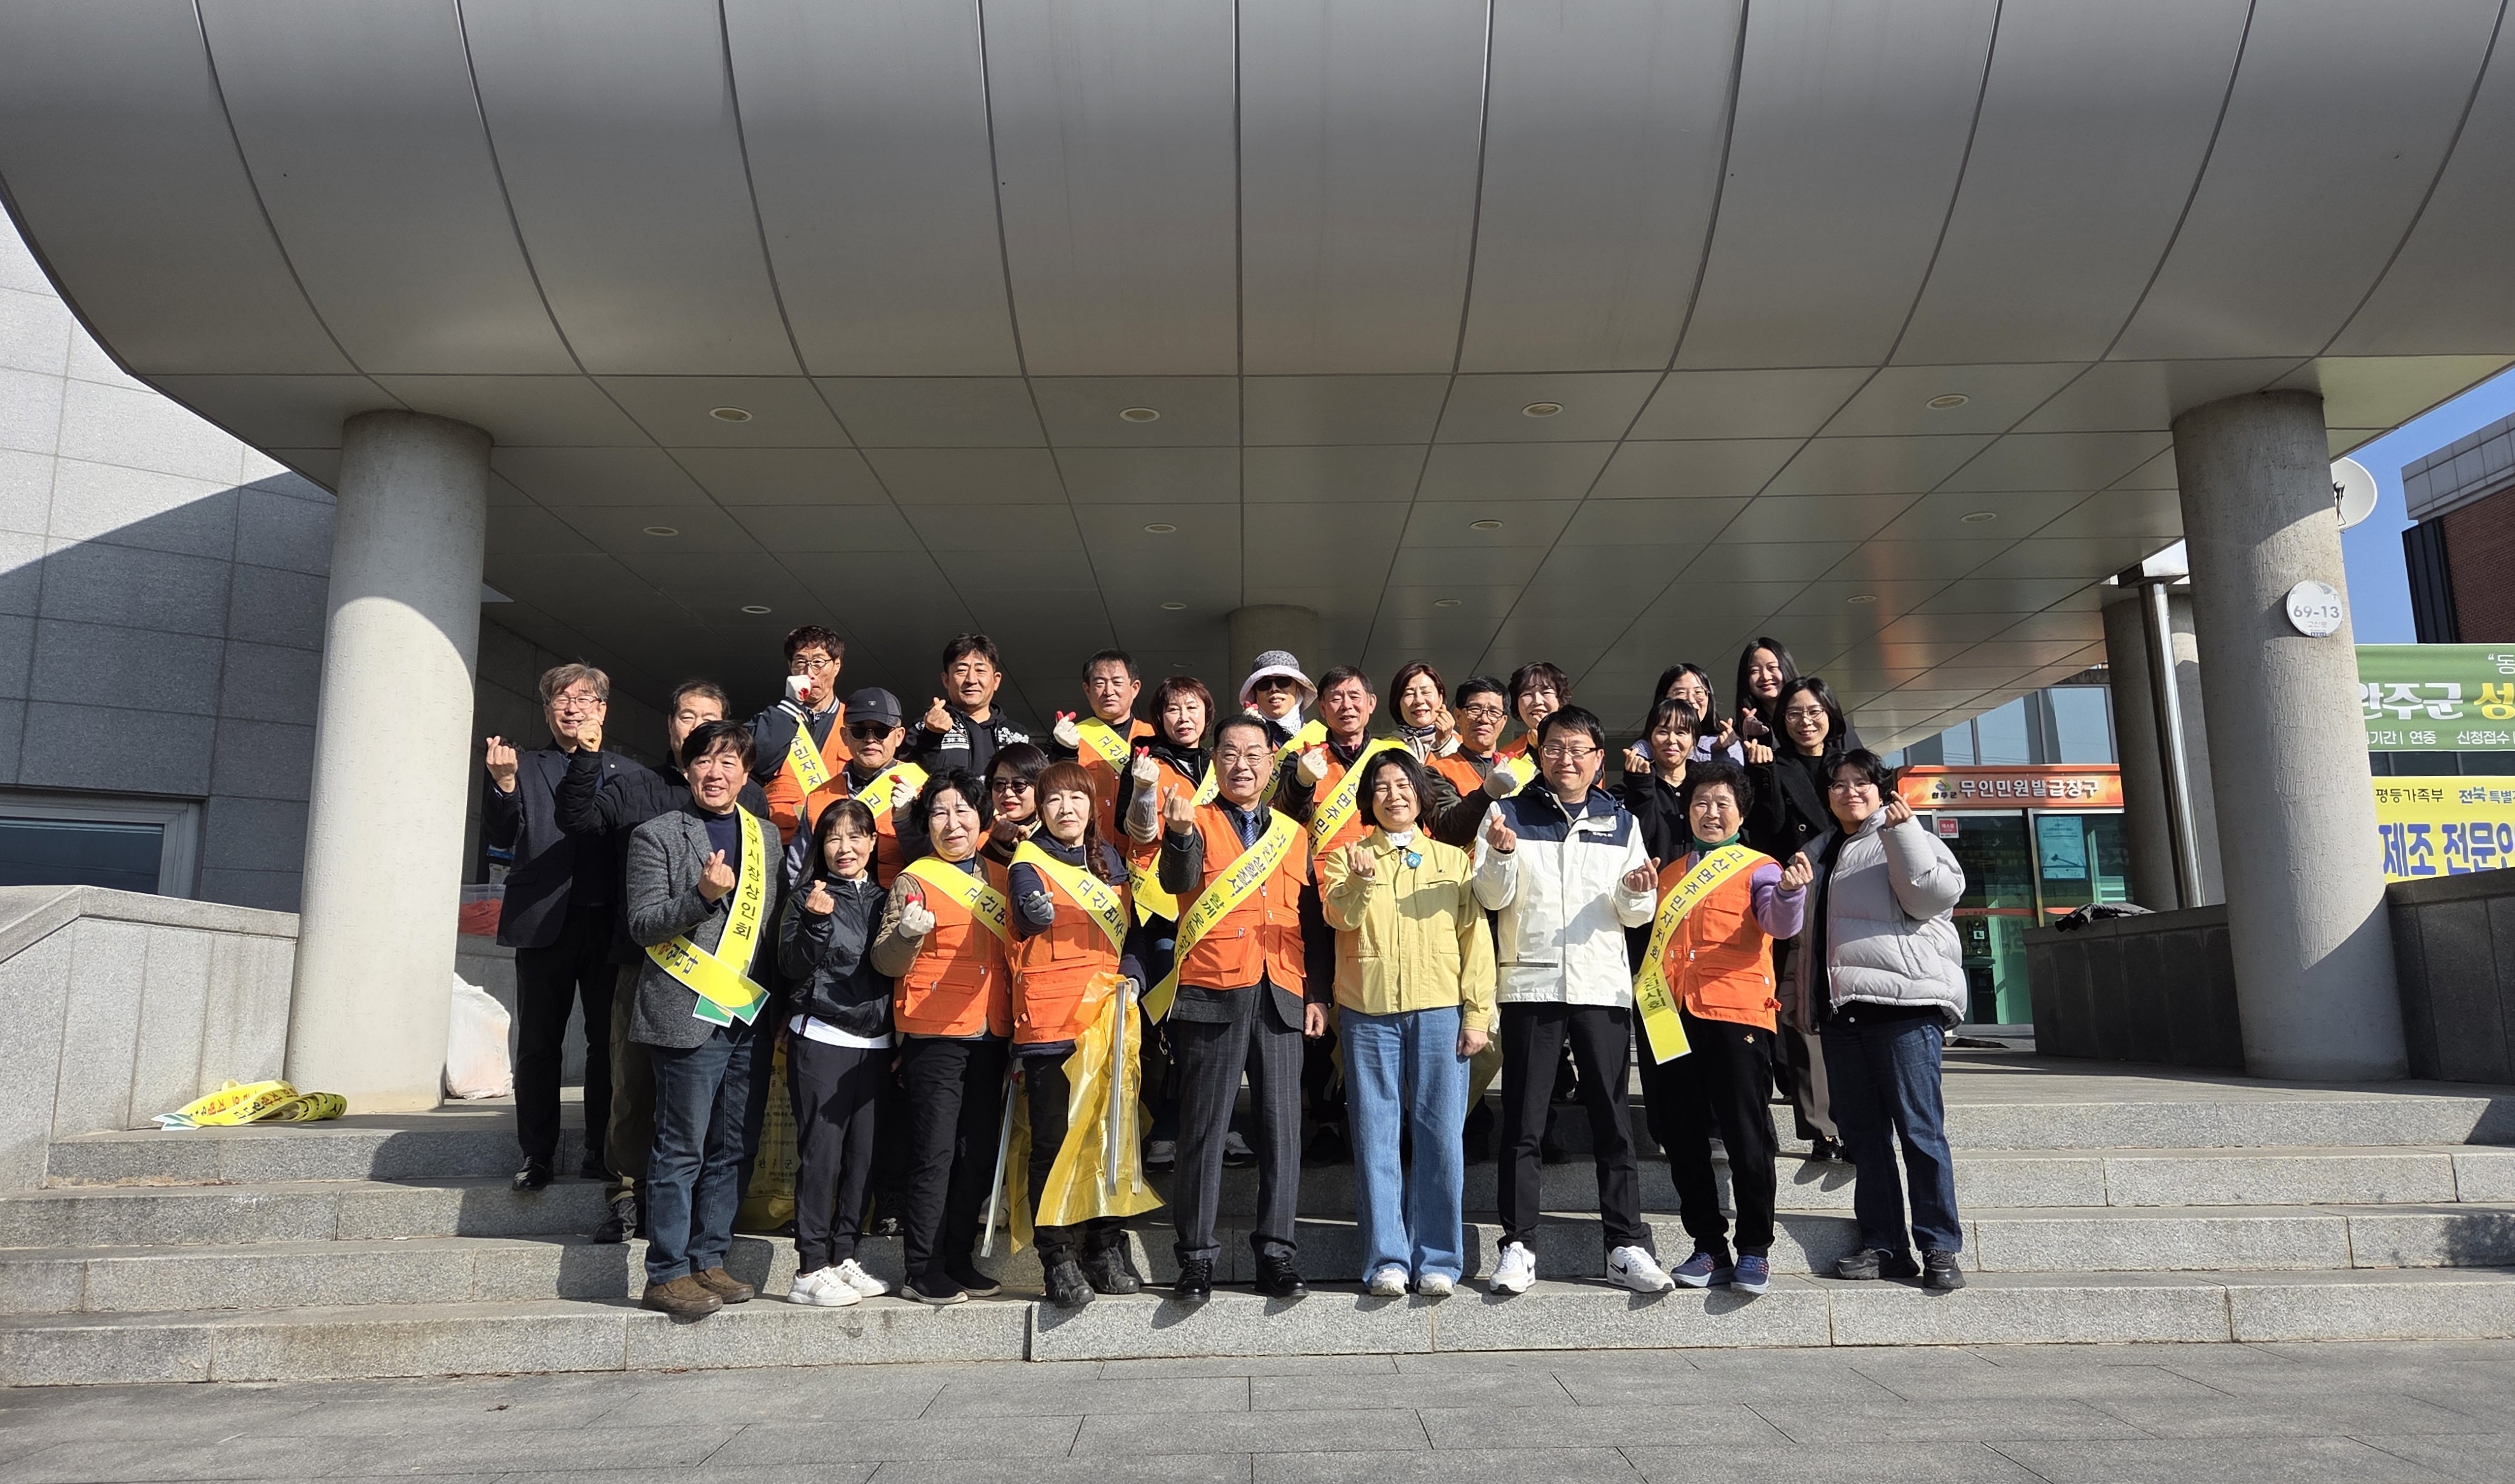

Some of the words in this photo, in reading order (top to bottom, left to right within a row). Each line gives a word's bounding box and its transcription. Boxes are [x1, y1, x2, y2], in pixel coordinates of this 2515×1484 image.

[2293, 605, 2340, 618] 69-13
[2409, 731, 2437, 745] 연중
[1960, 779, 2099, 798] 무인민원발급창구
[2378, 822, 2436, 877] 제조
[1202, 892, 1225, 919] 함께
[1649, 849, 1744, 962] 고산면주민자치회
